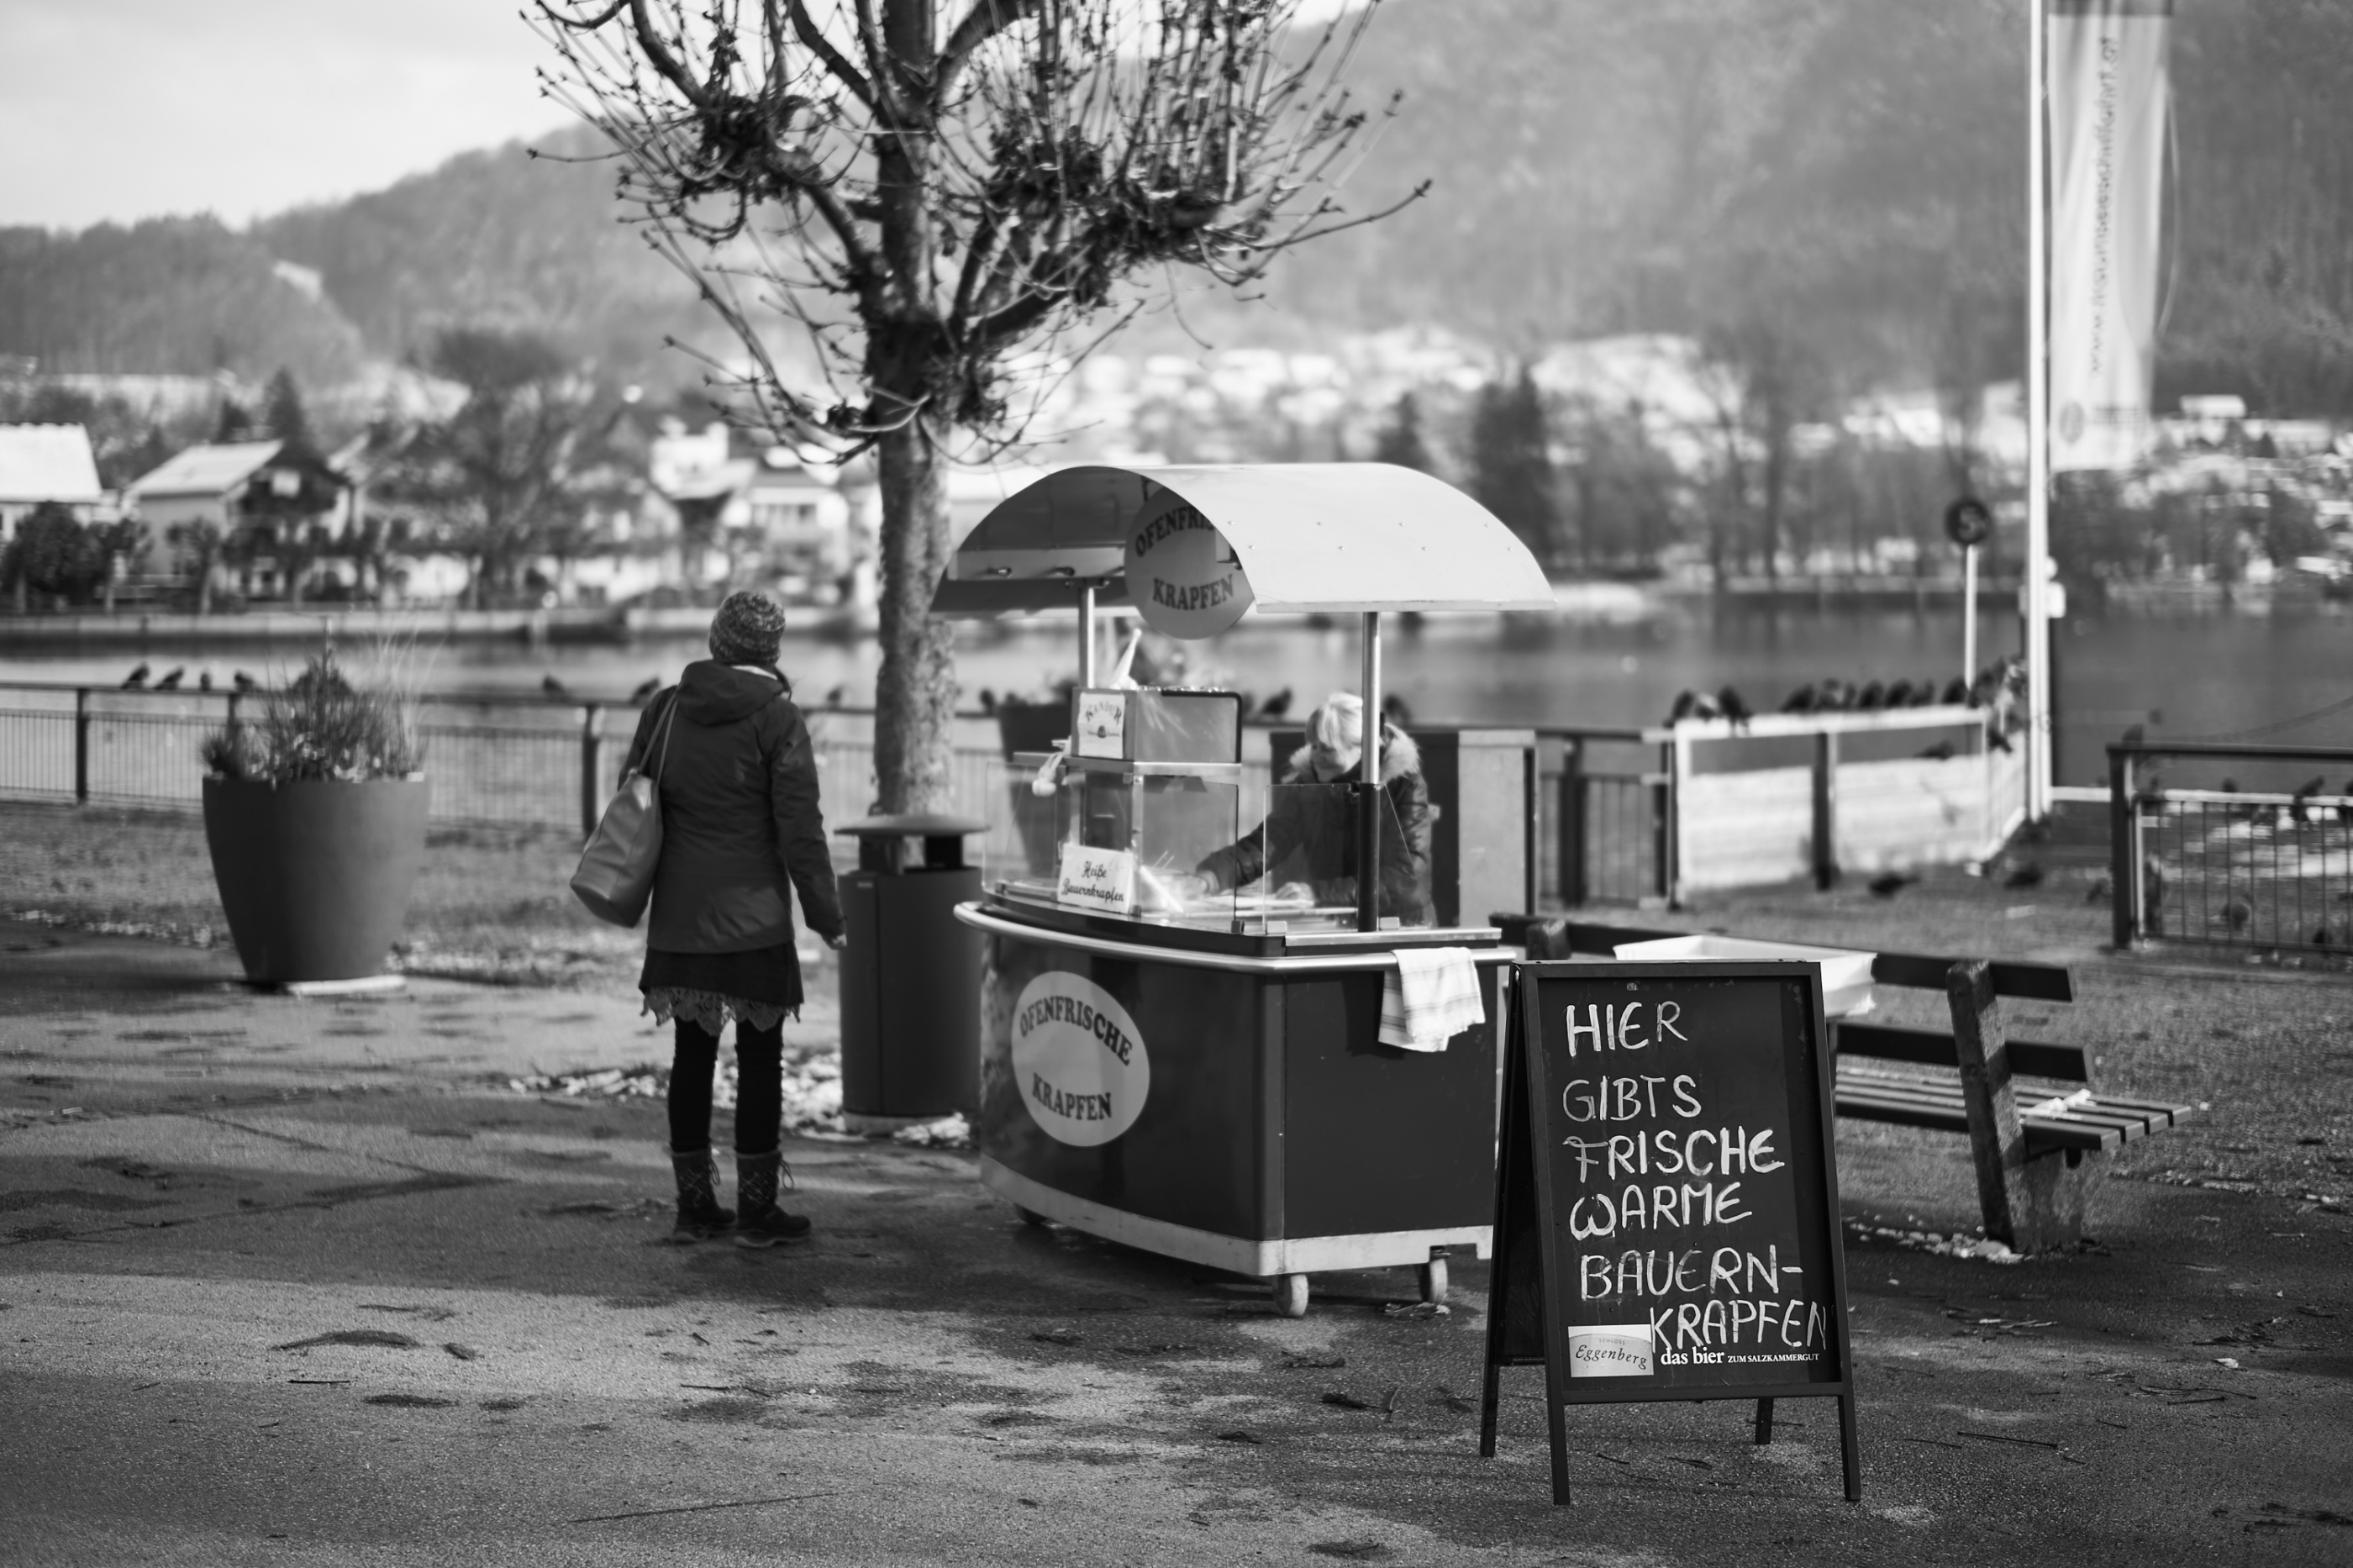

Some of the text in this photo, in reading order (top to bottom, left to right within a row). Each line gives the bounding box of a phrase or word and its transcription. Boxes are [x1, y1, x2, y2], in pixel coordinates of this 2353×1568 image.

[1152, 574, 1233, 611] KRAPFEN
[1061, 878, 1124, 904] Bauernkrapfen
[1082, 861, 1107, 881] Heiße
[1019, 996, 1133, 1066] OFENFRISCHE
[1566, 1002, 1687, 1057] HIER
[1033, 1072, 1112, 1121] KRAPFEN
[1563, 1075, 1702, 1122] GIBTS
[1562, 1126, 1785, 1183] FRISCHE
[1570, 1181, 1752, 1240] WARME
[1581, 1244, 1803, 1301] BAUERN-
[1650, 1299, 1826, 1353] KRAPFEN
[1575, 1344, 1647, 1370] Eggenberg
[1661, 1346, 1688, 1365] das
[1692, 1346, 1724, 1365] bier
[1748, 1354, 1819, 1363] SALZKAMMERGUT
